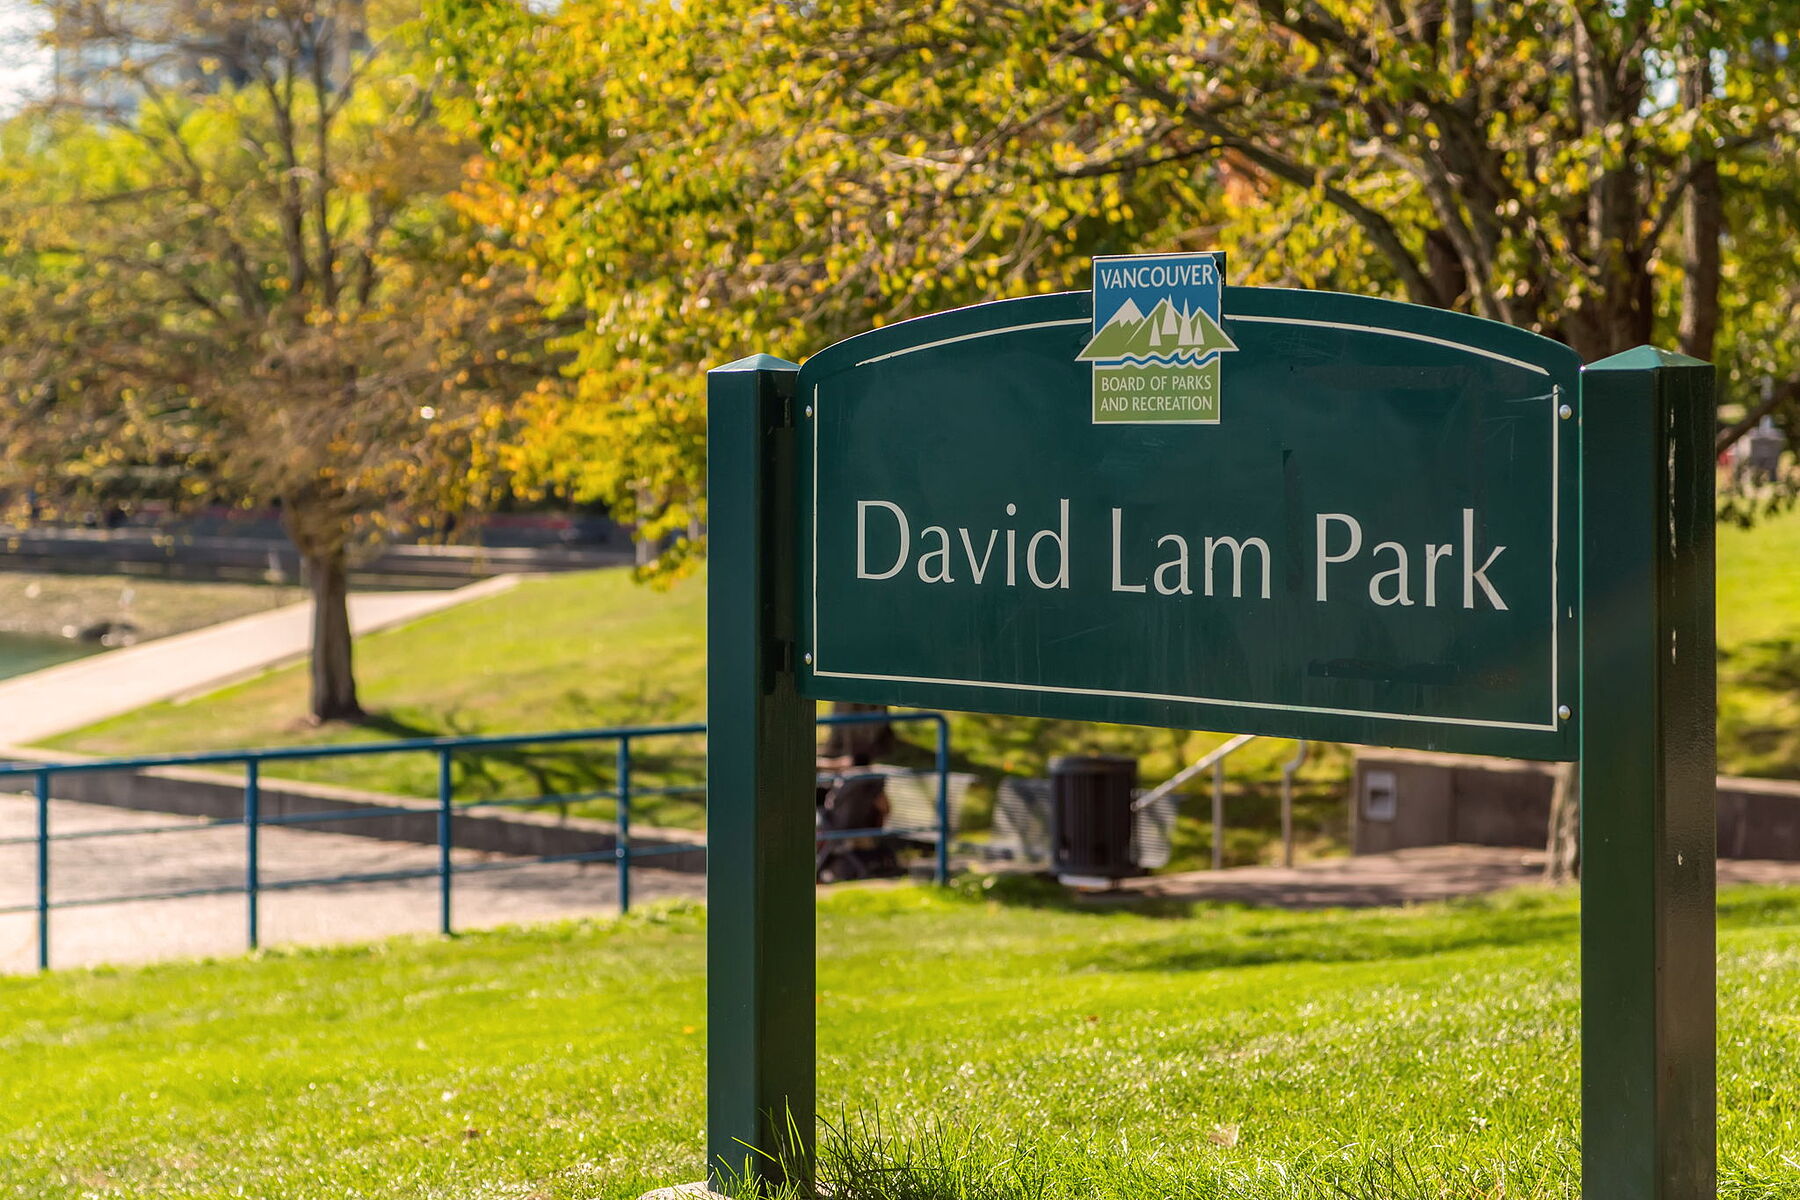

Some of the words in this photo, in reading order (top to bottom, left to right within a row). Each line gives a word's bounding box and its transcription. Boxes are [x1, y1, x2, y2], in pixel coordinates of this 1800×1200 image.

[1101, 264, 1214, 289] VANCOUVER
[1101, 376, 1145, 392] BOARD
[1150, 375, 1168, 391] OF
[1172, 375, 1212, 391] PARKS
[1100, 396, 1129, 412] AND
[1132, 395, 1213, 412] RECREATION
[856, 498, 1070, 589] David
[1111, 507, 1271, 599] Lam
[1316, 508, 1509, 611] Park
